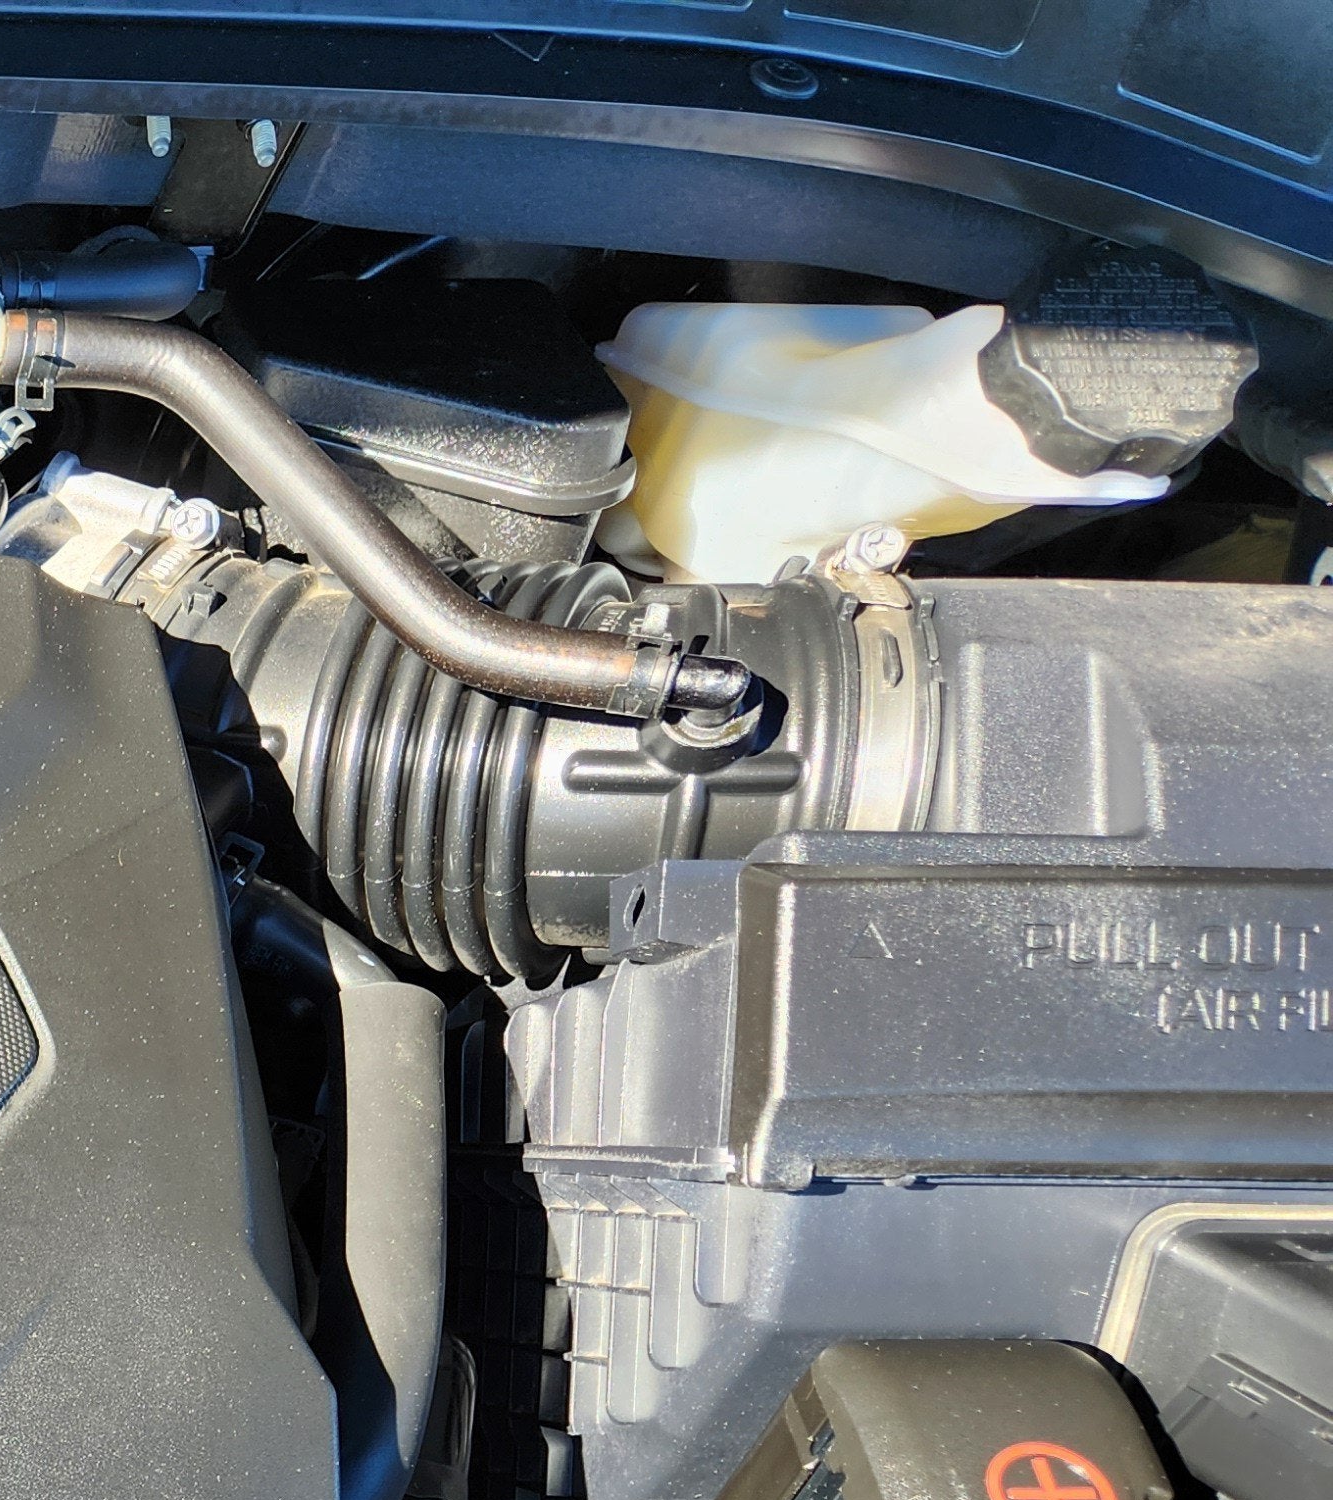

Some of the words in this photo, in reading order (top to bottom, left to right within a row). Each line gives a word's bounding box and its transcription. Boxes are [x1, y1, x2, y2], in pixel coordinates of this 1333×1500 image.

[1021, 921, 1179, 970] PULL
[1199, 921, 1320, 972] OUT
[1156, 984, 1260, 1034] (AIR
